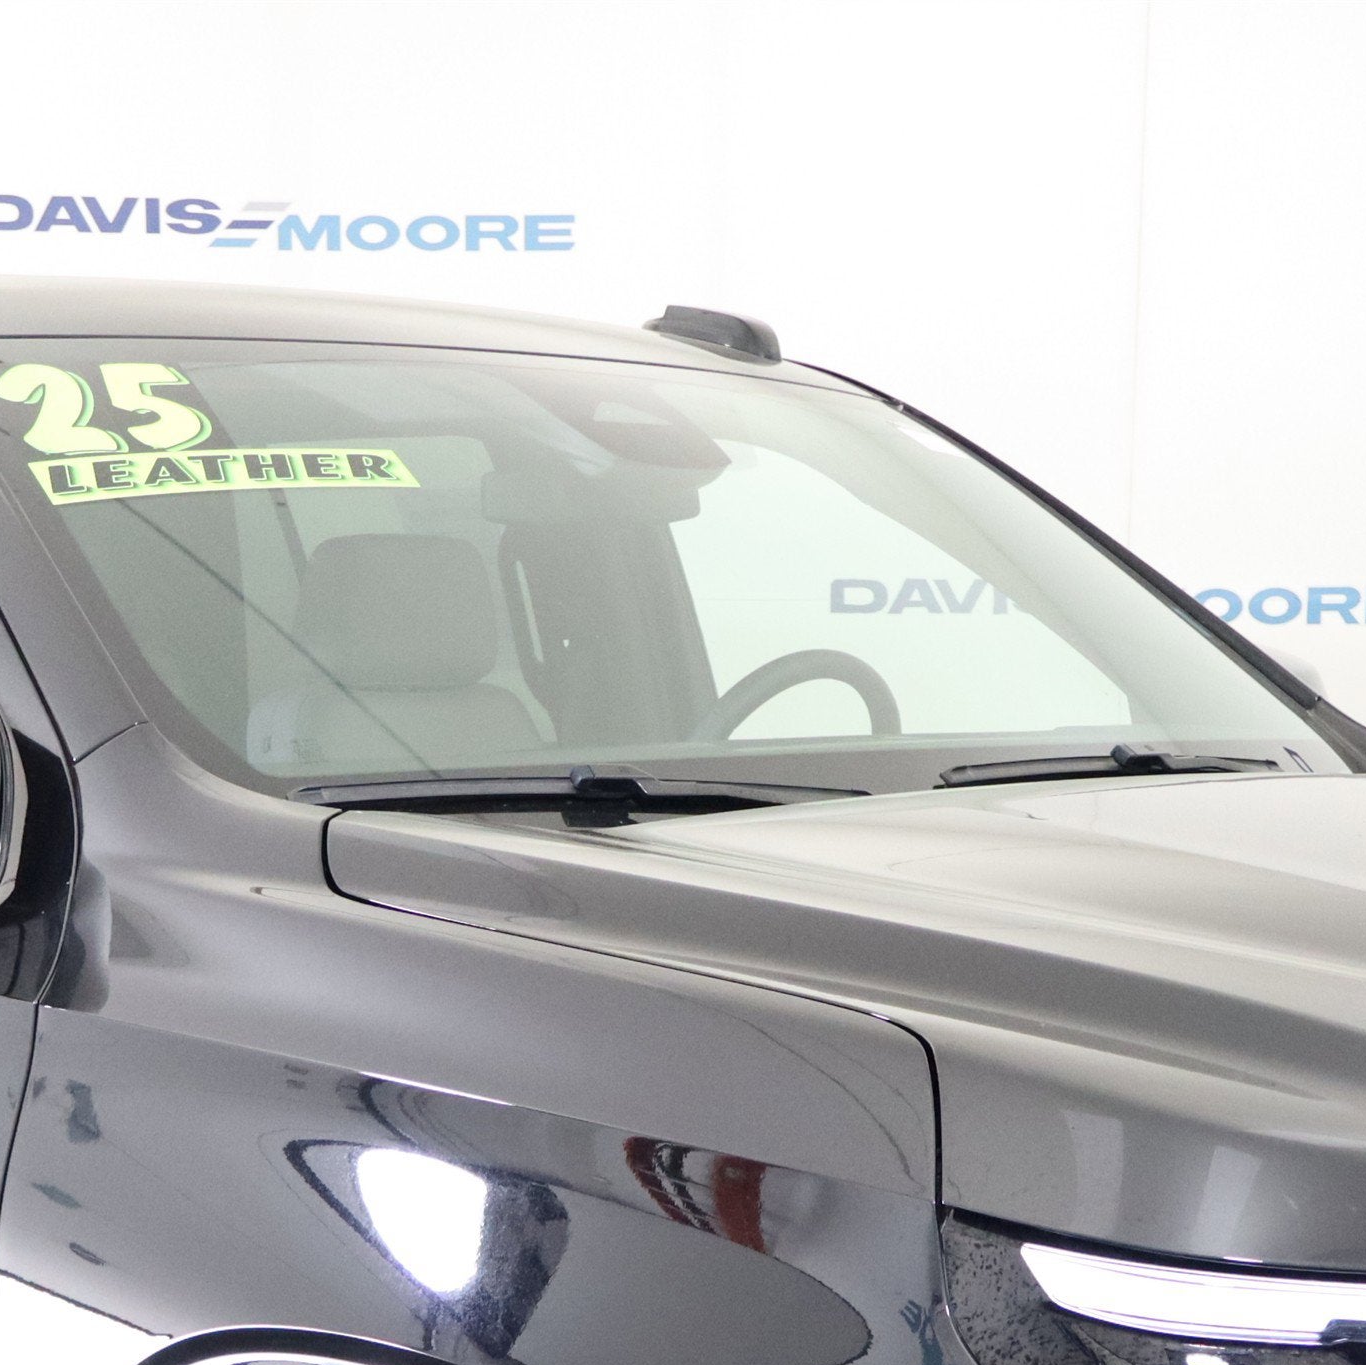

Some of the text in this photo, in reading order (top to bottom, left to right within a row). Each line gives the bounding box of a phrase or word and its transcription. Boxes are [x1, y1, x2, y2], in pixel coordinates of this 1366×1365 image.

[277, 214, 576, 252] MOORE
[46, 452, 400, 496] LEATHER
[829, 577, 1009, 615] DAVI
